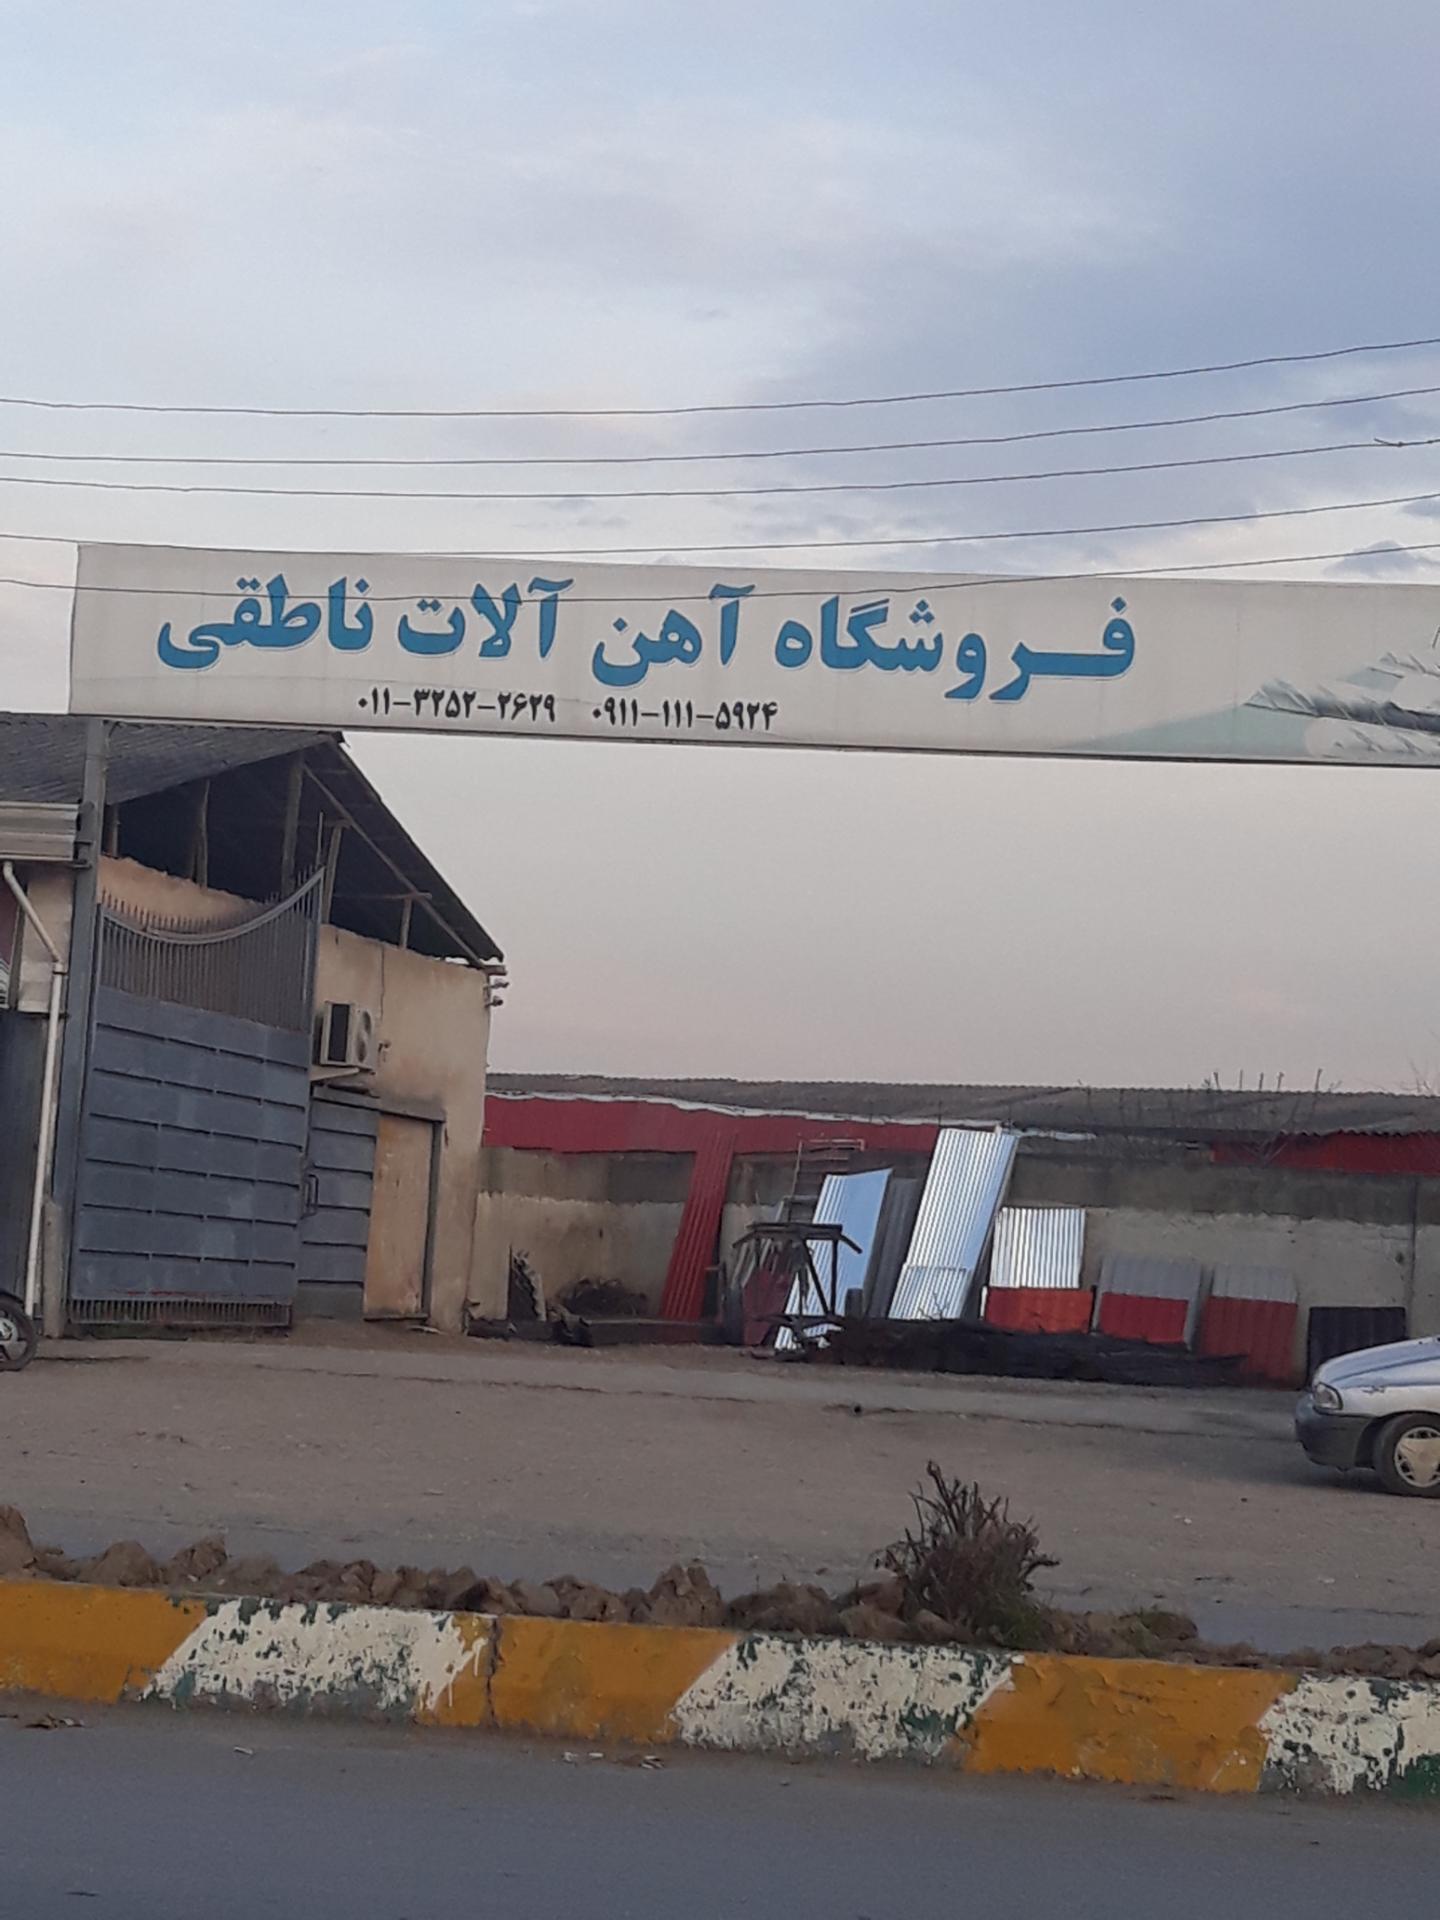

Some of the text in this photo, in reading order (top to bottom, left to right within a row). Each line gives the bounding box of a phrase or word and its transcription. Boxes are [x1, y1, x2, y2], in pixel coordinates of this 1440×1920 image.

[157, 573, 1136, 702] فروشگاه آهن آلات ناطقی
